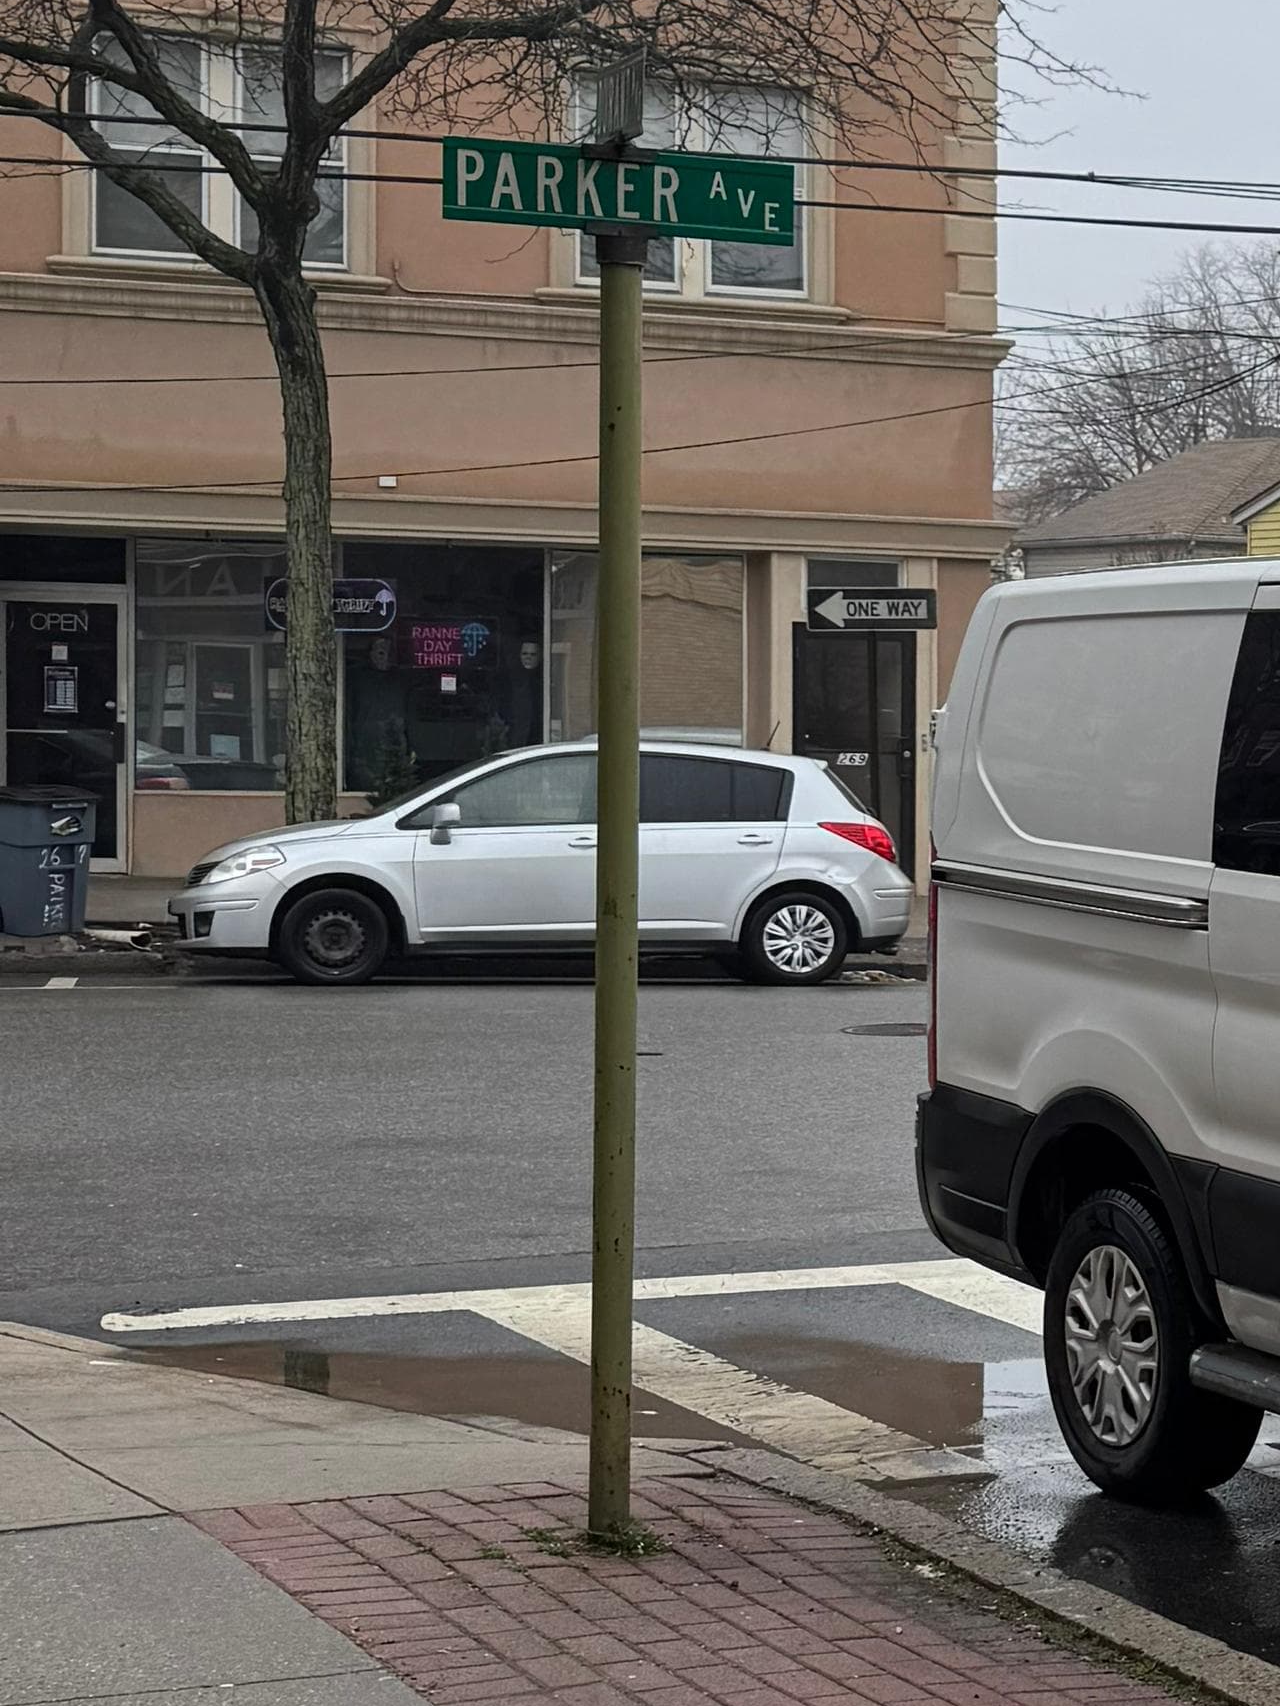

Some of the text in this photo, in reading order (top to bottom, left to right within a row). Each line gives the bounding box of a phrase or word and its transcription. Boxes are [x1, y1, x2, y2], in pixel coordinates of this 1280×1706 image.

[456, 149, 780, 232] PARKER AVE
[846, 601, 922, 617] ONE WAY
[30, 613, 88, 631] OPEN
[412, 626, 460, 640] RANNE
[423, 640, 453, 653] DAY
[414, 653, 463, 666] THRIFT
[838, 753, 867, 765] 269
